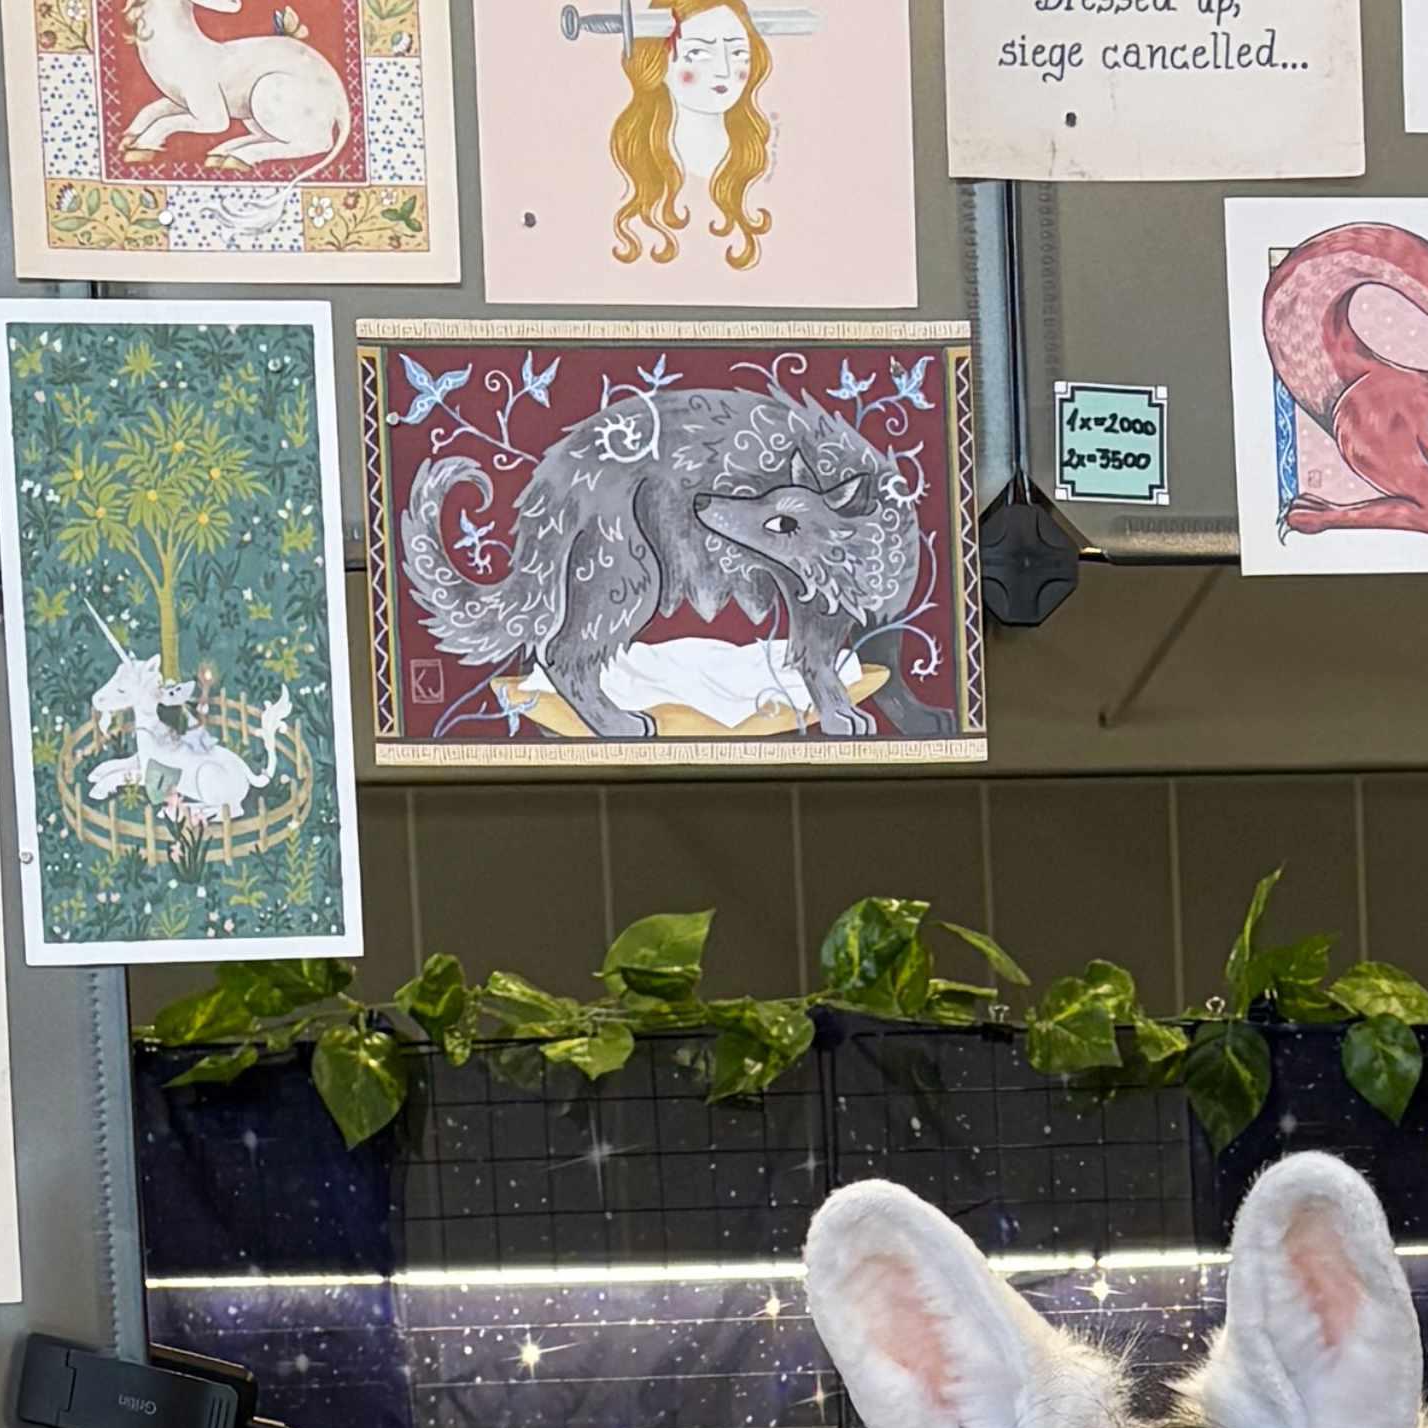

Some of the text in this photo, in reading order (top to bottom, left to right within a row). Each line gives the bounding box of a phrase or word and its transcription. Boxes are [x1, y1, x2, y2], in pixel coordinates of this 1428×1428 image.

[998, 36, 1310, 83] siege cancelled...
[1066, 411, 1157, 438] 1x=2000
[1061, 448, 1152, 472] 2x=3500
